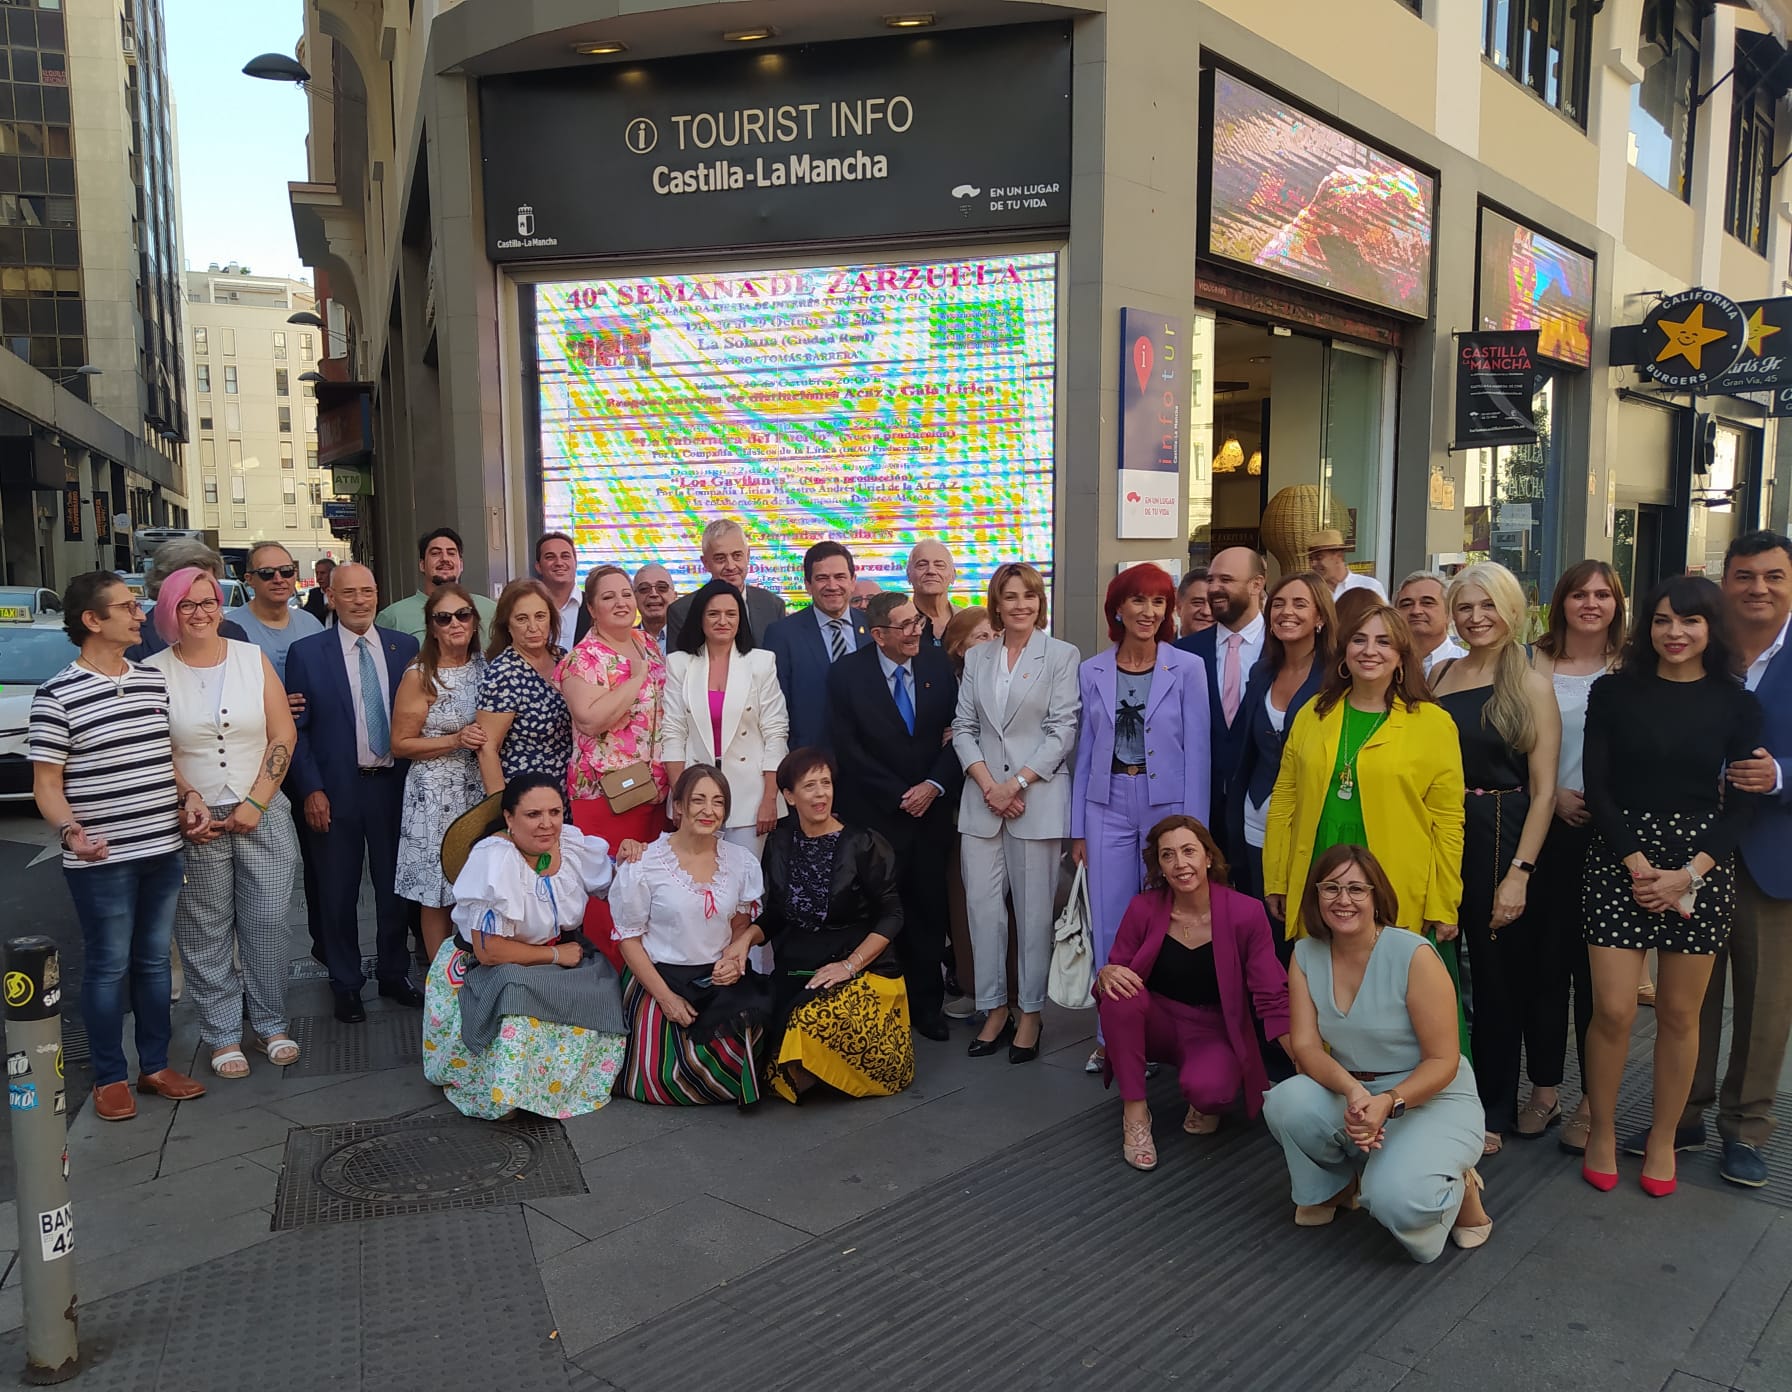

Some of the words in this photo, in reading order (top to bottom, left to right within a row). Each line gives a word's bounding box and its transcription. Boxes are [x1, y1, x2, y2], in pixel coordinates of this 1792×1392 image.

[671, 102, 820, 151] TOURIST
[831, 95, 914, 138] INFO
[990, 188, 1004, 197] EN
[1006, 186, 1021, 196] UN
[1024, 183, 1060, 195] LUGAR
[990, 201, 1004, 211] DE
[1006, 200, 1020, 210] TU
[1023, 198, 1047, 208] VIDA
[618, 279, 759, 306] SEMANA
[769, 274, 816, 297] DE
[828, 263, 1023, 294] ZARZUELA
[1662, 291, 1738, 320] CALIFORNIA
[697, 337, 719, 350] La
[725, 335, 778, 349] Solana
[781, 333, 837, 347] (Ciudad
[1462, 346, 1528, 359] CASTILLA
[1470, 359, 1532, 370] MANCHA
[1646, 364, 1707, 385] BURGERS
[1723, 379, 1744, 387] Gran
[1764, 374, 1778, 383] 45
[335, 475, 361, 485] ATM
[749, 561, 806, 574] Divertid
